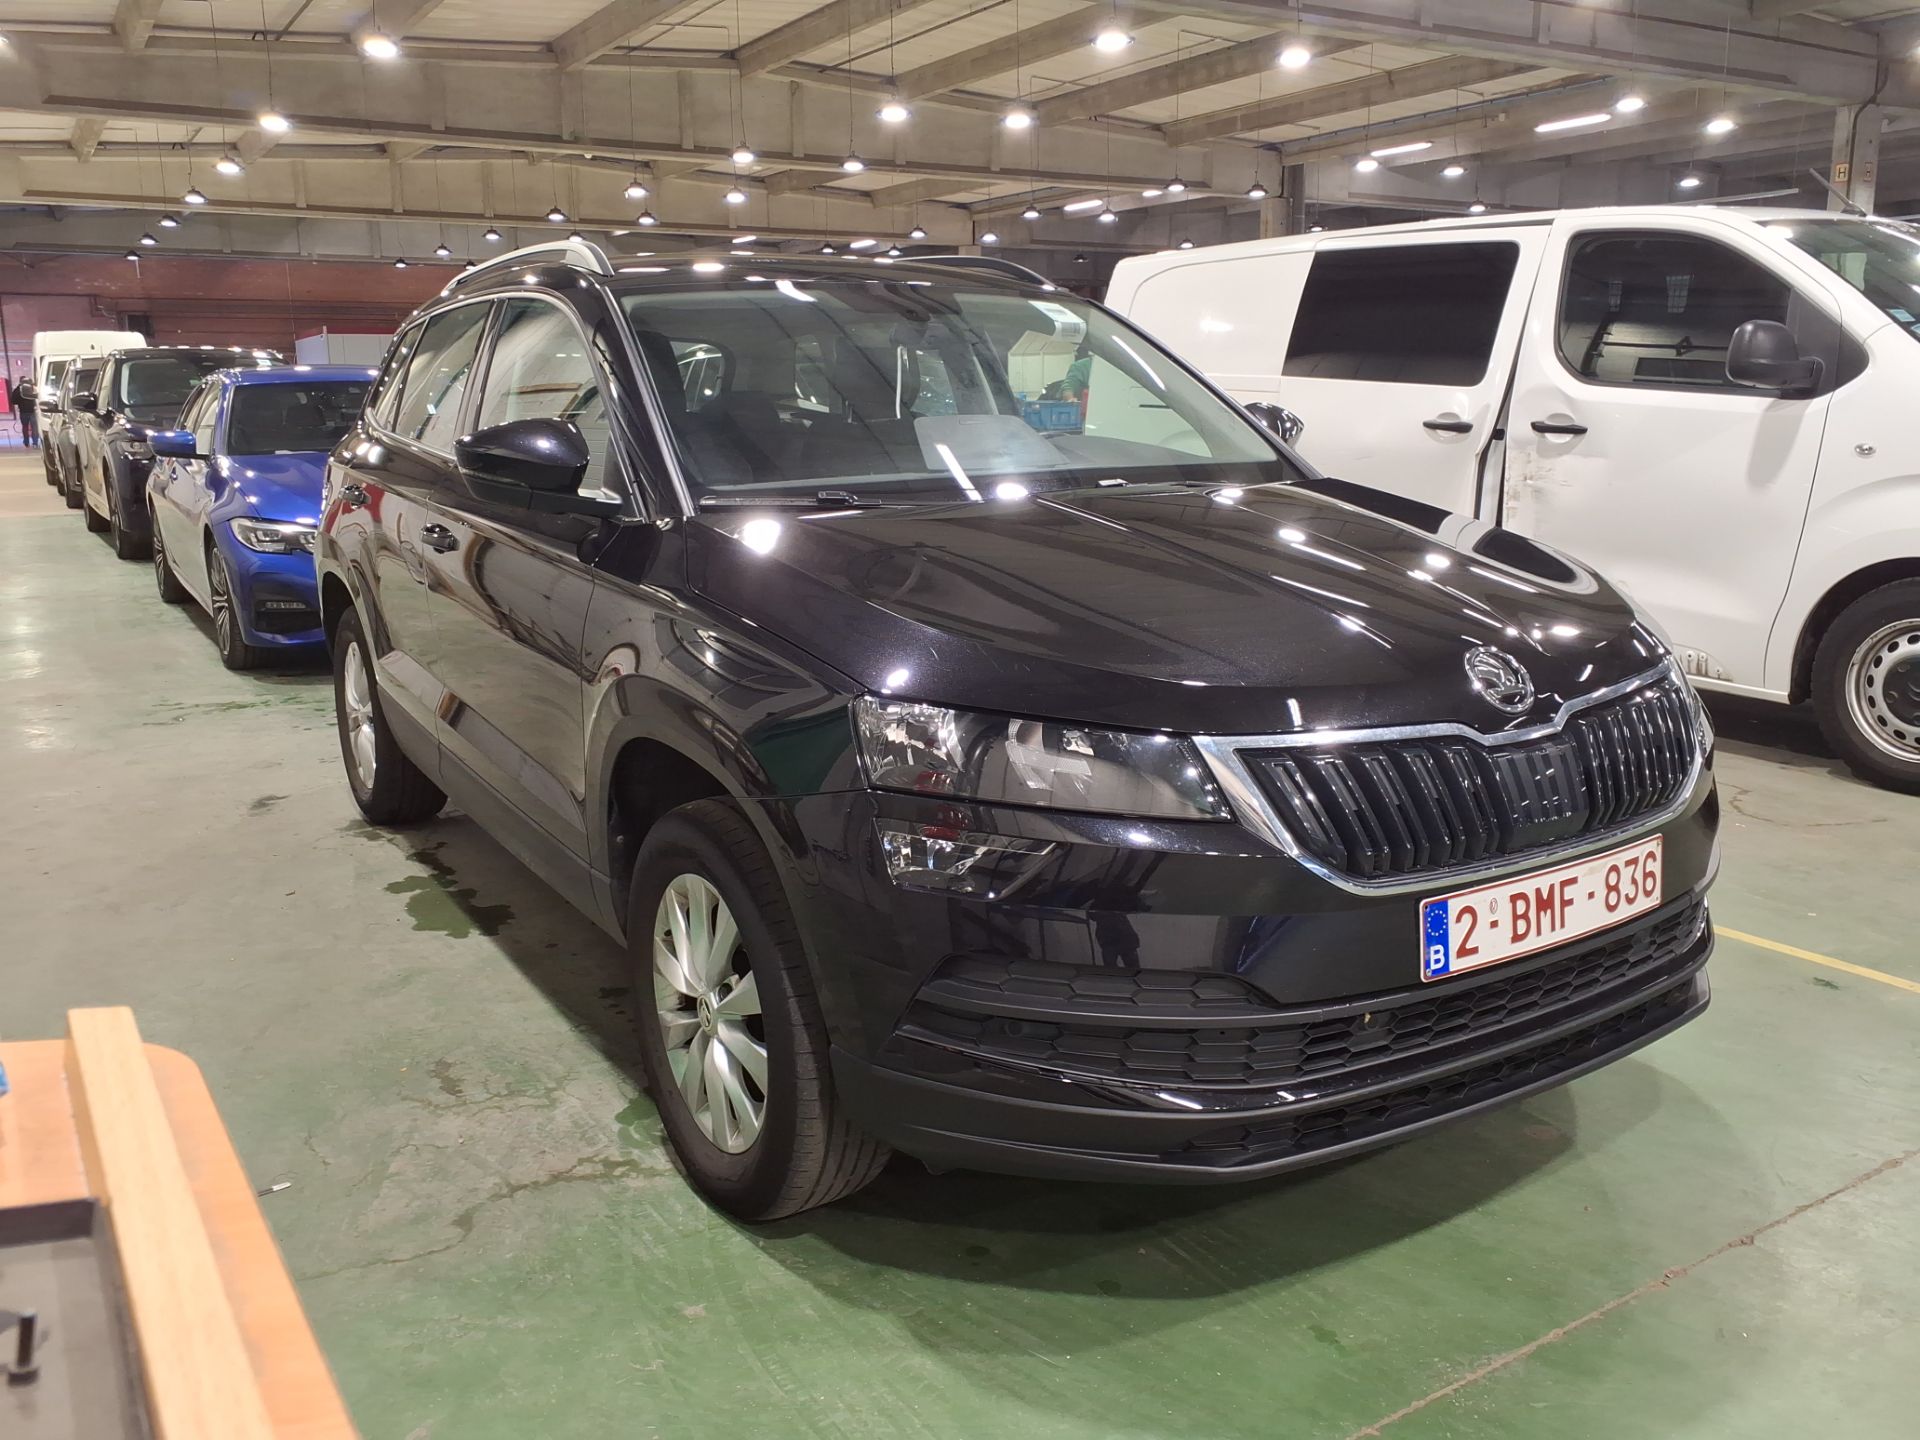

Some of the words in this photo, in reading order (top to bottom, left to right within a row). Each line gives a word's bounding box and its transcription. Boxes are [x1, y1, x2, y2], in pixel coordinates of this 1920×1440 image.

[1838, 167, 1847, 179] H
[1455, 850, 1658, 960] 2-BMF-836
[1430, 944, 1446, 970] B
